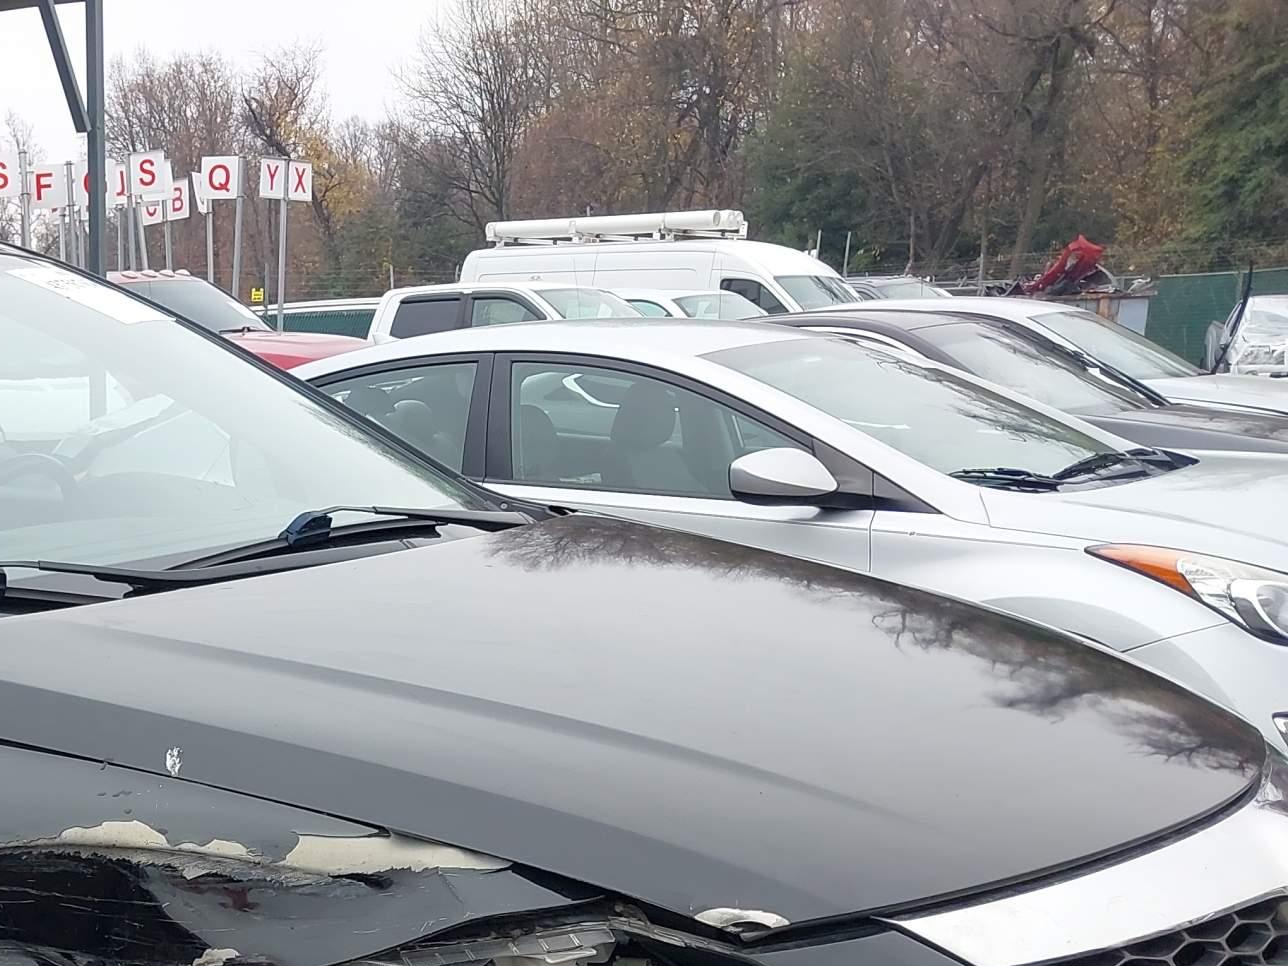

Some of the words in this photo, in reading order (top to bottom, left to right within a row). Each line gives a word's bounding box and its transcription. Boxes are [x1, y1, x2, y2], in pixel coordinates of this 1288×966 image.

[35, 172, 53, 201] F
[139, 159, 156, 187] S
[208, 163, 232, 193] Q
[266, 164, 281, 191] Y
[294, 167, 308, 194] X
